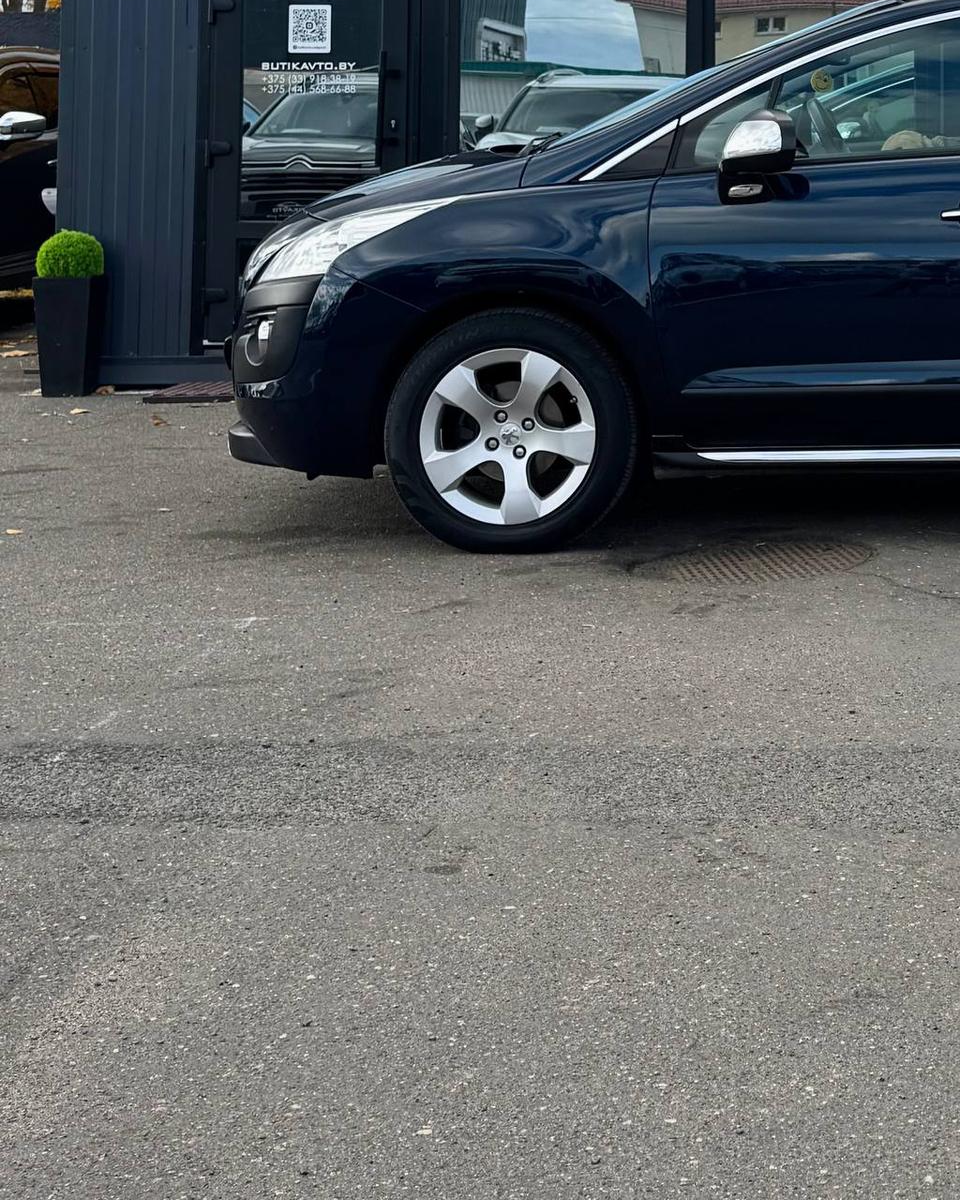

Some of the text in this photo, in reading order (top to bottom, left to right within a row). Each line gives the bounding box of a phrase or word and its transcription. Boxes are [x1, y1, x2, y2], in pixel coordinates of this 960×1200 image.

[261, 62, 356, 70] BUTIKAVTO.BY
[262, 74, 285, 83] +375
[288, 74, 306, 85] (33)
[262, 84, 356, 95] +375 (44) 568-66-88
